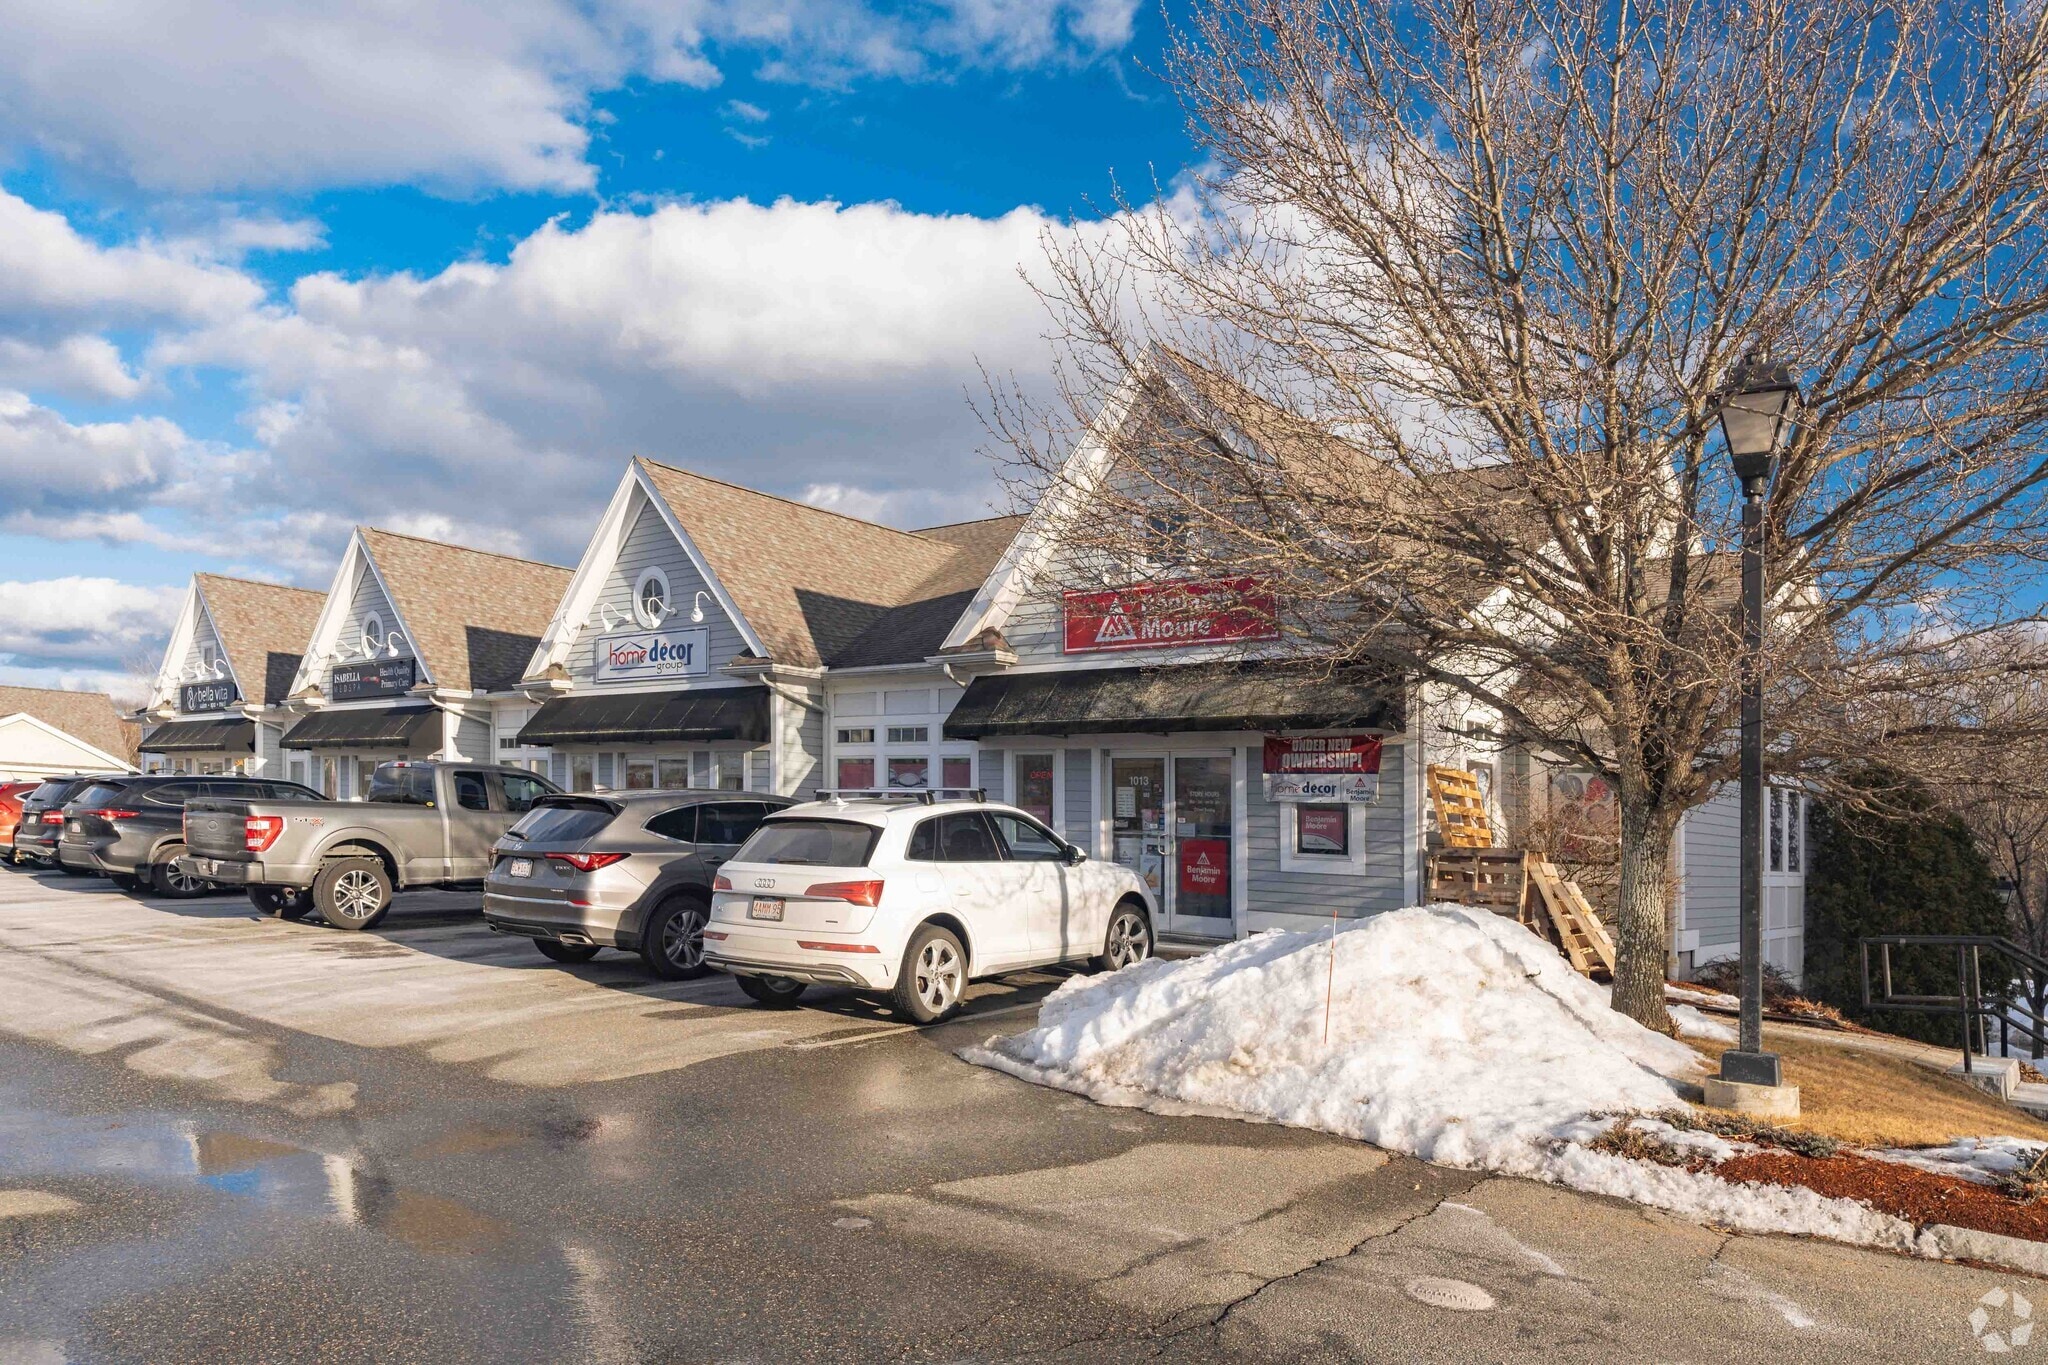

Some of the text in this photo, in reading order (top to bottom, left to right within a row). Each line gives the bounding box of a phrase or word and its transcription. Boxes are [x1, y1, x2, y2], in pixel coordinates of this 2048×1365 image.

[1141, 620, 1210, 640] Moore
[609, 639, 693, 665] home décor
[380, 665, 410, 677] Health Quality
[656, 660, 683, 674] group
[334, 672, 360, 684] ISABELLA
[381, 678, 409, 689] Primary Care
[197, 686, 228, 702] bella vita
[1292, 739, 1352, 751] UNDER NEW
[1281, 752, 1362, 768] OWNERSHIP!
[1030, 769, 1054, 779] OPEN
[1129, 776, 1149, 786] 1013
[1345, 788, 1375, 796] Benjamin
[1305, 815, 1337, 824] Benjamin
[1305, 822, 1328, 830] Moore
[1187, 865, 1221, 875] Benjamin
[1192, 874, 1216, 884] Moore
